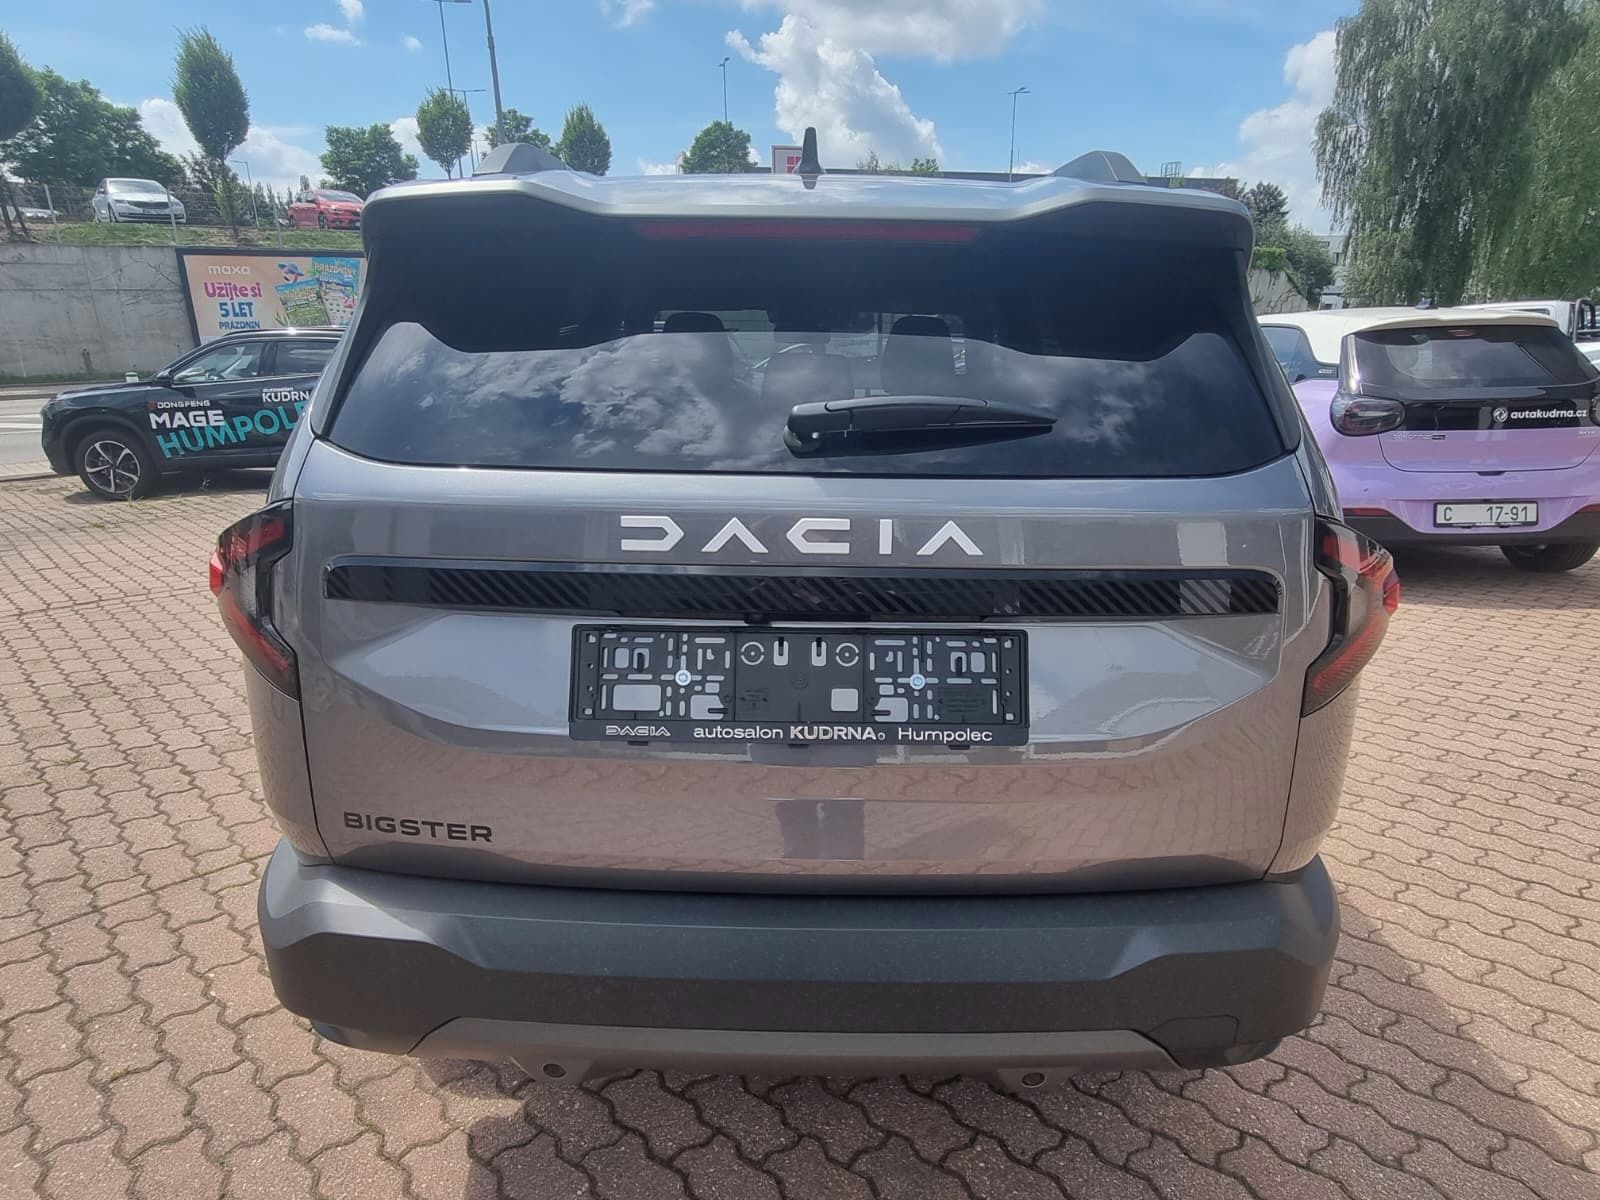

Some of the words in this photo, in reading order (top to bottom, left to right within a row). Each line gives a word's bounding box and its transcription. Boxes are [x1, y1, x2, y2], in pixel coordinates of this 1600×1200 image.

[208, 265, 250, 275] maxa
[203, 282, 249, 301] Užijte
[250, 282, 262, 298] si
[218, 302, 230, 318] 5
[231, 302, 254, 318] LET
[157, 400, 211, 409] DONGFENG
[262, 391, 310, 403] KUDRN
[149, 409, 225, 430] MAGE
[1510, 407, 1588, 420] autakudrna.cz
[1443, 507, 1453, 522] C
[1486, 506, 1528, 522] 17-91
[620, 515, 985, 556] DACIA
[605, 725, 671, 737] DACIA
[693, 725, 784, 739] autosalon
[898, 727, 993, 743] Humpolec
[343, 811, 493, 843] BIGSTER
